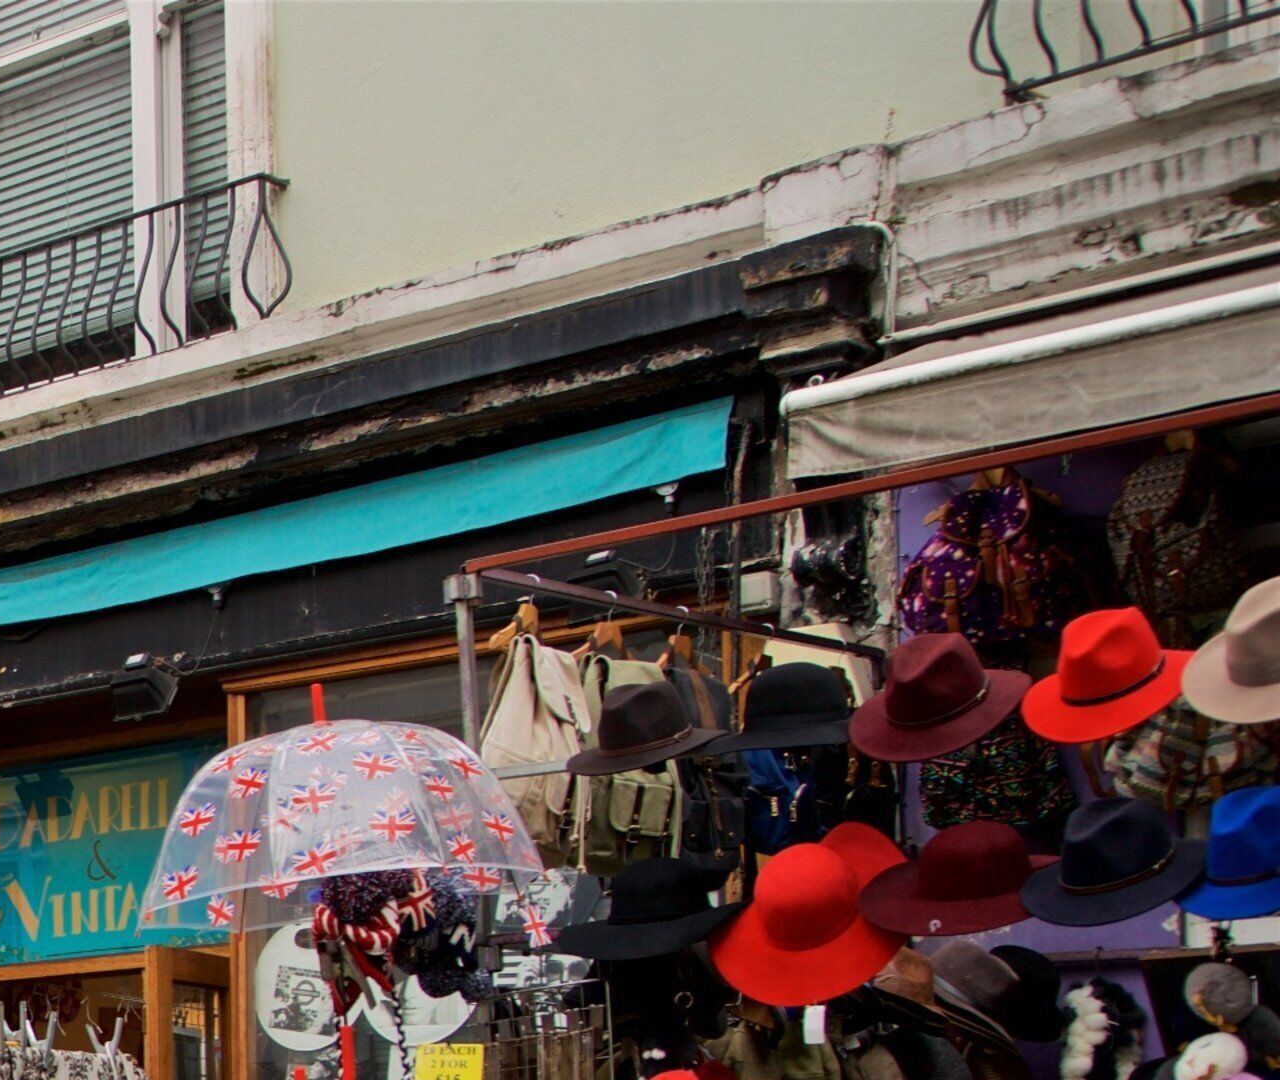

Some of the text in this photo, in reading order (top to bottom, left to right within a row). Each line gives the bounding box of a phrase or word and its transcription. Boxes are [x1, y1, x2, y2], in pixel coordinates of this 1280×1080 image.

[86, 839, 117, 882] &
[439, 1046, 477, 1056] EACH
[430, 1059, 468, 1069] 2 FOR
